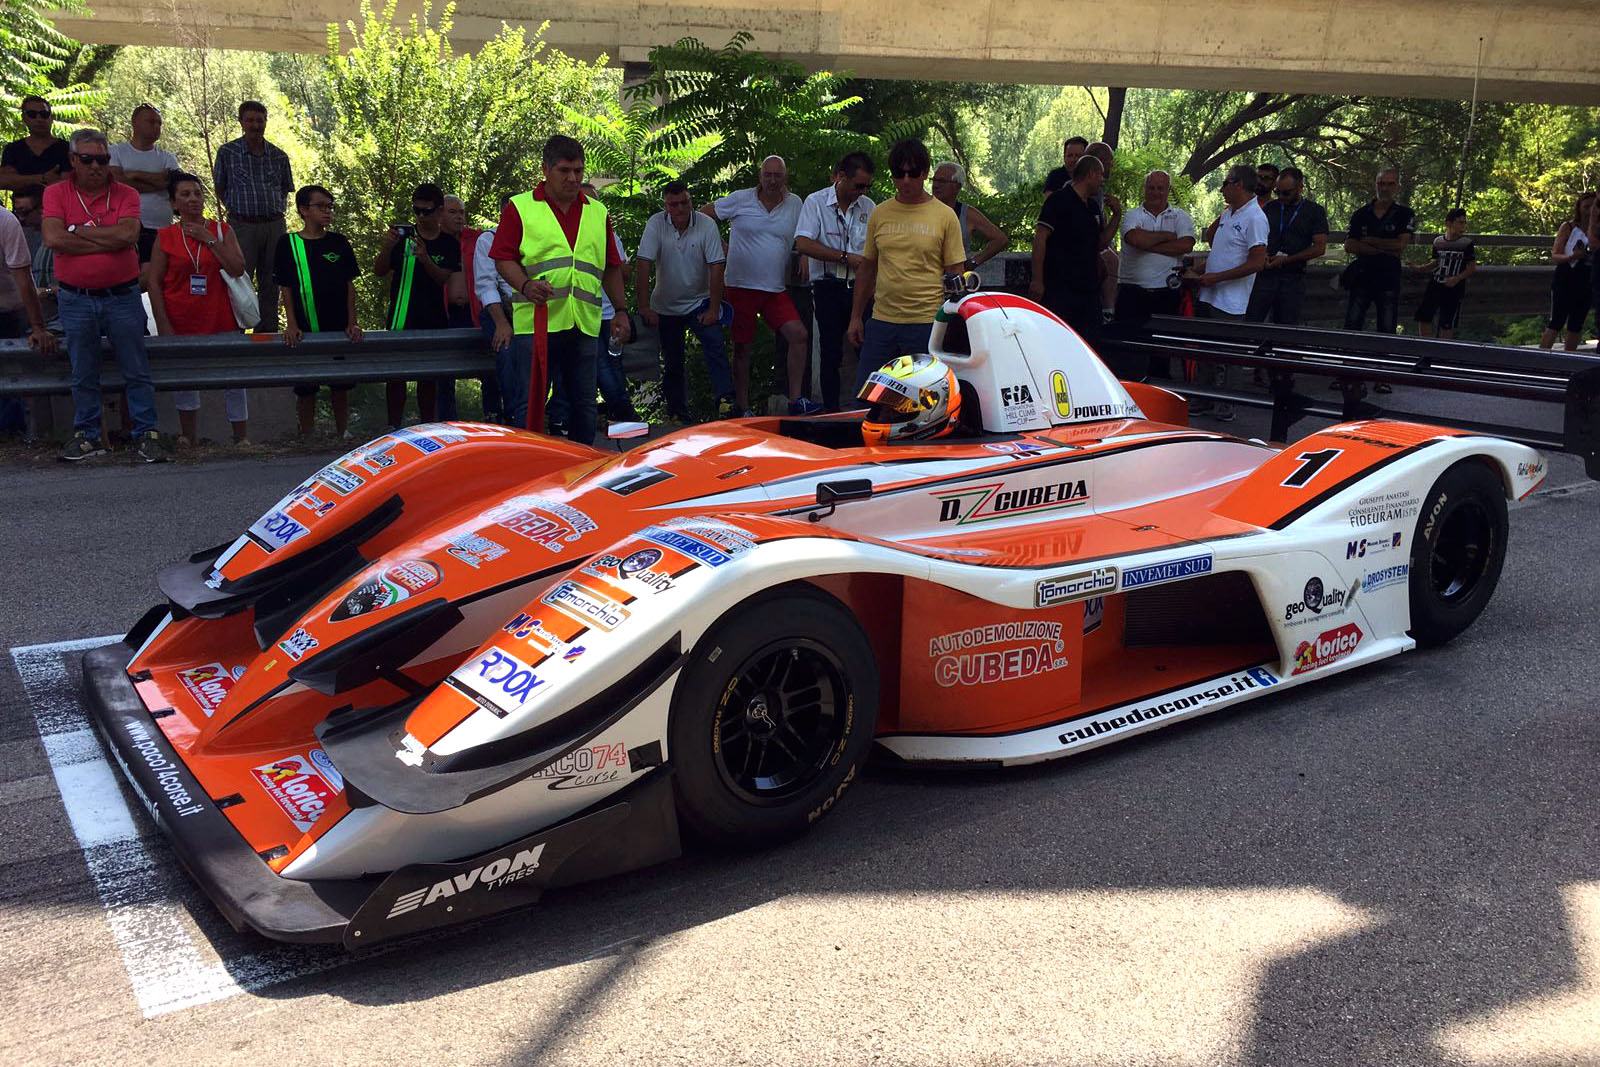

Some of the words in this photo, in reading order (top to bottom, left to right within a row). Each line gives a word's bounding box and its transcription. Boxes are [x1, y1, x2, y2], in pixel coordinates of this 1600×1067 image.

[1006, 411, 1020, 419] HILL
[1020, 408, 1036, 418] CLIMB
[1074, 404, 1111, 418] POWER
[1281, 449, 1344, 488] 1
[994, 480, 1088, 511] CUBEDA
[1350, 509, 1402, 528] FIDEURAM
[1424, 492, 1448, 539] AVON
[690, 544, 725, 565] SUD
[1124, 563, 1182, 586] INVEMET
[1184, 558, 1210, 573] SUD
[929, 620, 1063, 657] AUTODEMOLIZIONE
[479, 651, 546, 704] RDOX
[935, 643, 1053, 688] CUBEDA
[1059, 675, 1256, 745] cubedacorse.it
[124, 720, 205, 817] www.paco74corse.it
[808, 762, 856, 823] AVON
[422, 843, 546, 907] AVON
[488, 866, 536, 891] TYRES
